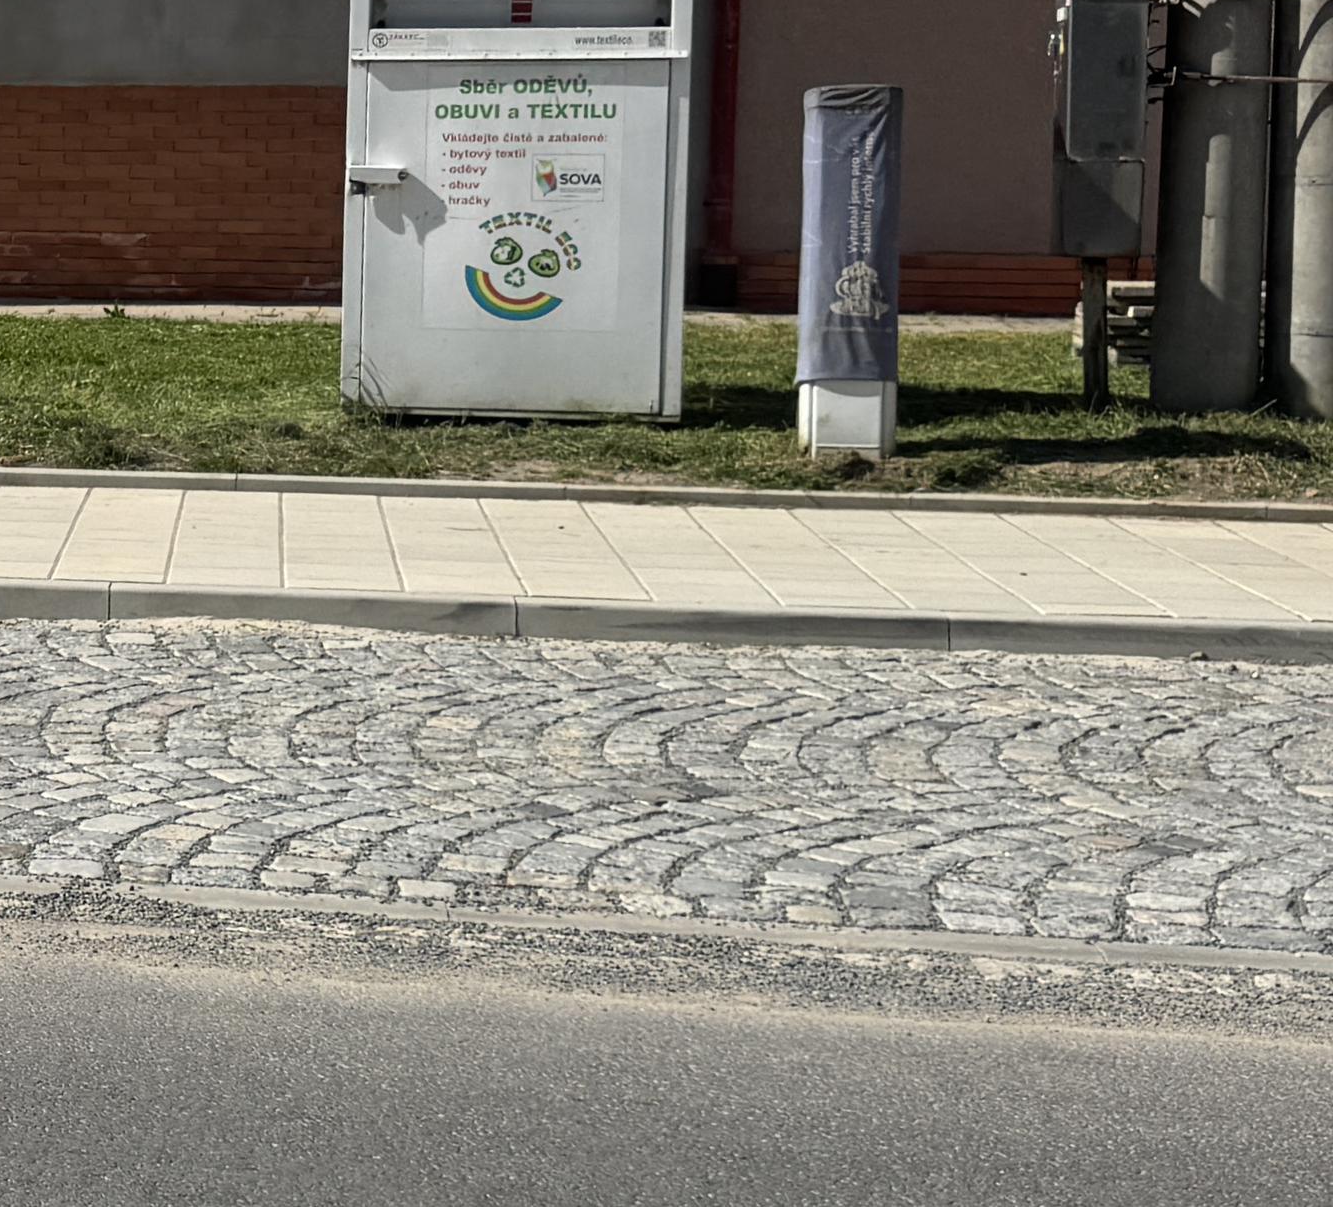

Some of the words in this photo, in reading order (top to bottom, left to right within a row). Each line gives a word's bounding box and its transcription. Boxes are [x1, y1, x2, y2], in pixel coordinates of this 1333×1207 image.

[459, 78, 508, 95] Sběr
[512, 73, 593, 97] ODĚVŮ,
[435, 103, 501, 120] OBUVI
[507, 106, 520, 120] a
[526, 103, 617, 120] TEXTILU
[442, 132, 499, 145] Vkládejte
[502, 132, 533, 144] čisté
[537, 135, 545, 144] a
[548, 132, 609, 144] zabalené:
[449, 148, 492, 161] bytový
[495, 148, 527, 159] textil
[449, 164, 488, 176] oděvy
[850, 157, 861, 176] pro
[448, 179, 480, 191] obuv
[559, 173, 602, 185] SOVA
[448, 195, 491, 207] hračky
[478, 211, 553, 235] TEXTIL
[554, 230, 582, 271] ECO
